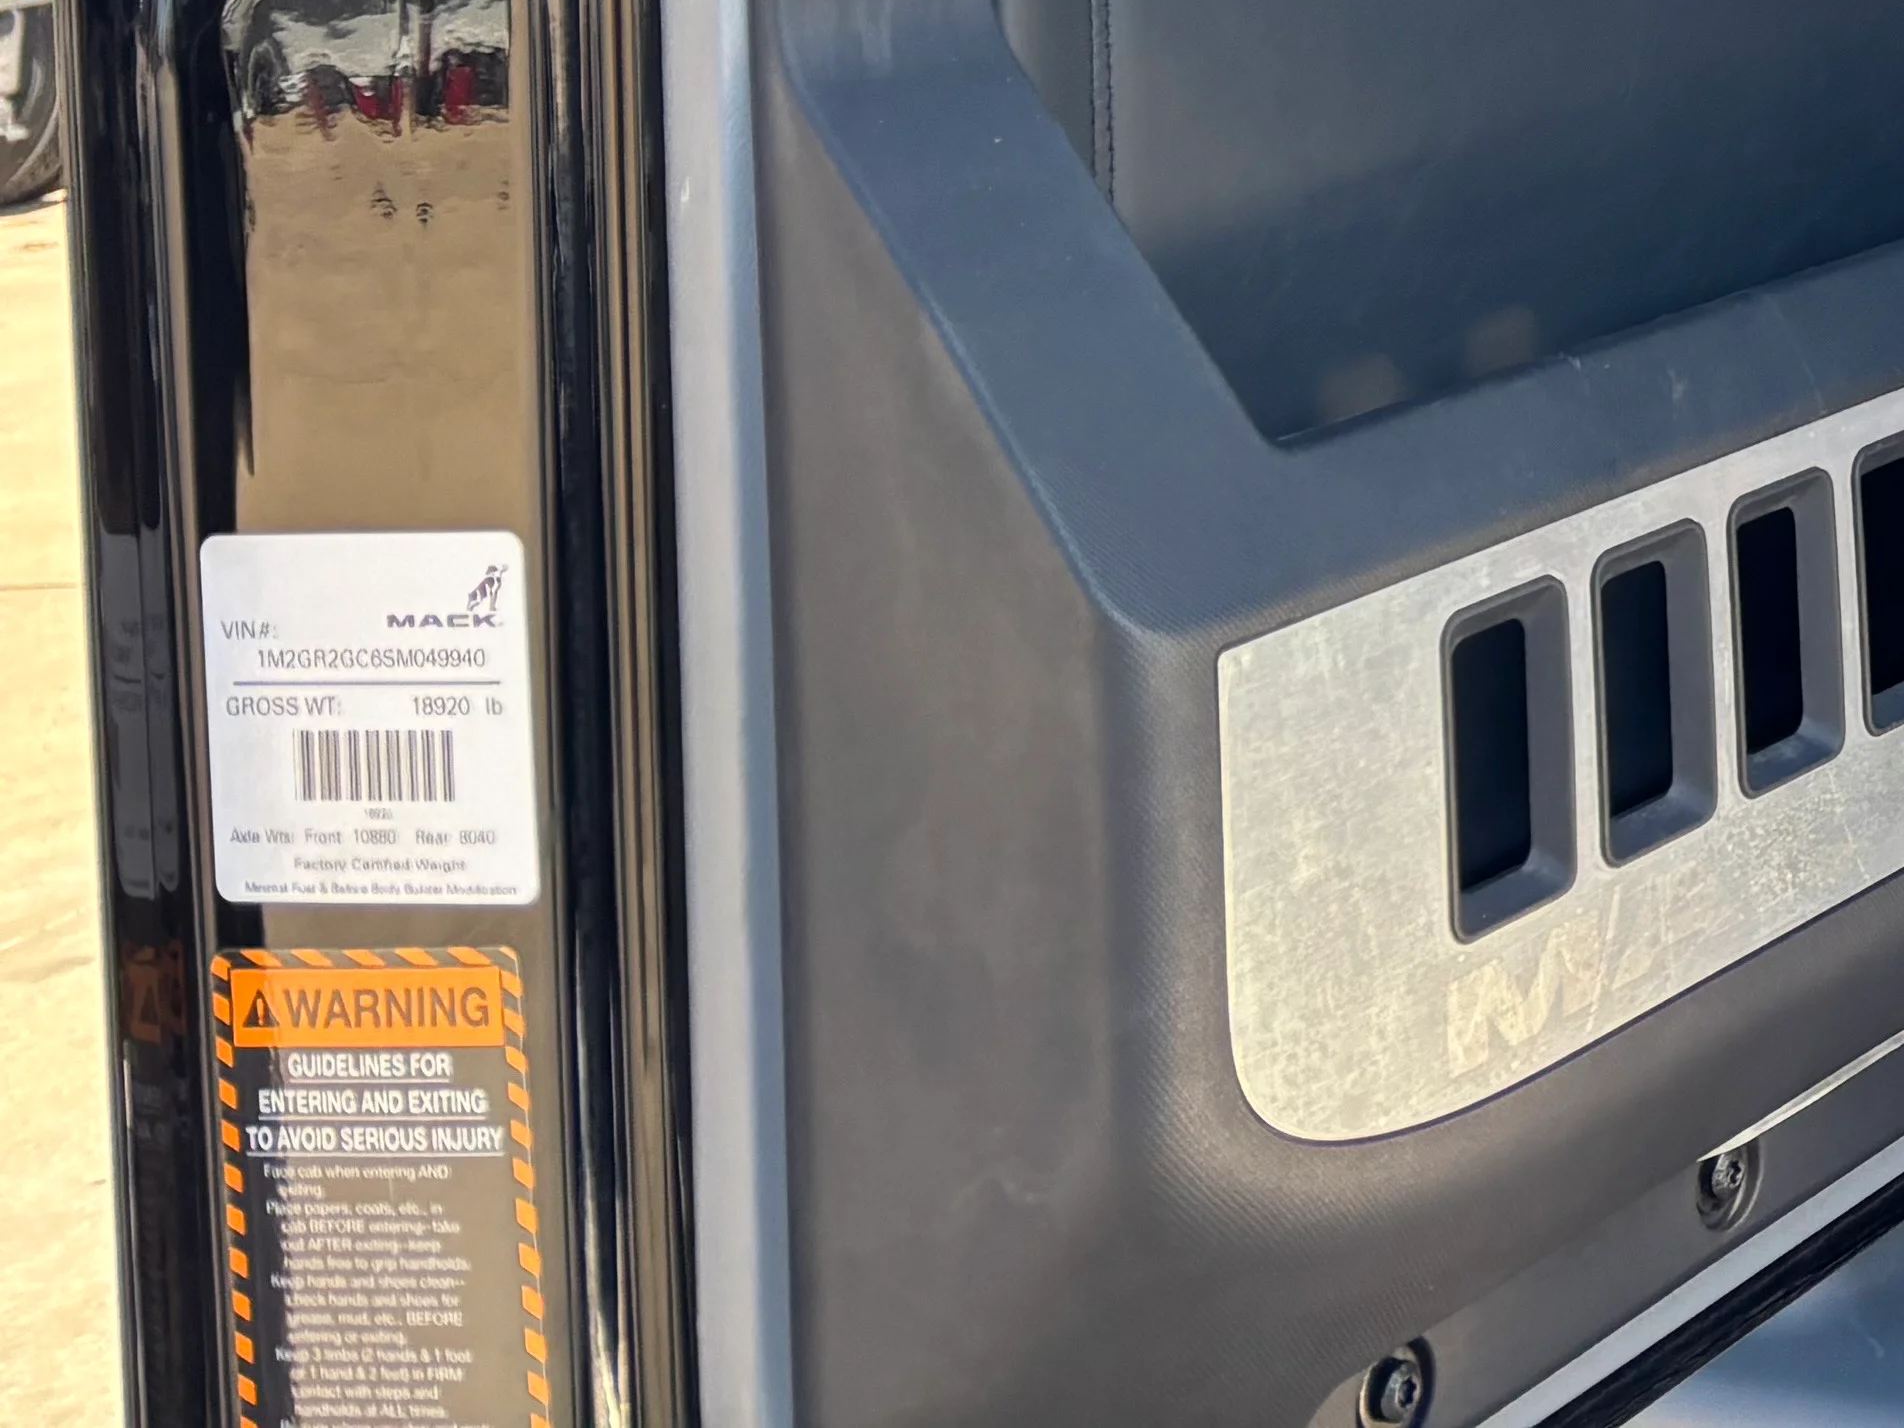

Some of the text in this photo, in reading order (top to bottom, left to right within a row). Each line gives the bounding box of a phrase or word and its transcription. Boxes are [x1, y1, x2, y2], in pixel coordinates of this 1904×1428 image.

[386, 614, 497, 628] MACK
[225, 696, 503, 716] GROSS WT: 18920 lb
[294, 857, 347, 874] Factory
[282, 987, 489, 1028] WARNING
[288, 1052, 452, 1077] GUIDELINES FOR
[258, 1089, 489, 1114] ENTERING AND EXITING
[246, 1126, 503, 1151] TO AVOID SERIOUS INJURY
[299, 1164, 323, 1179] cab
[325, 1164, 360, 1179] when
[418, 1164, 449, 1179] AND
[309, 1220, 365, 1233] BEFORE
[308, 1239, 351, 1252] AFTER
[406, 1312, 463, 1326] BEFORE
